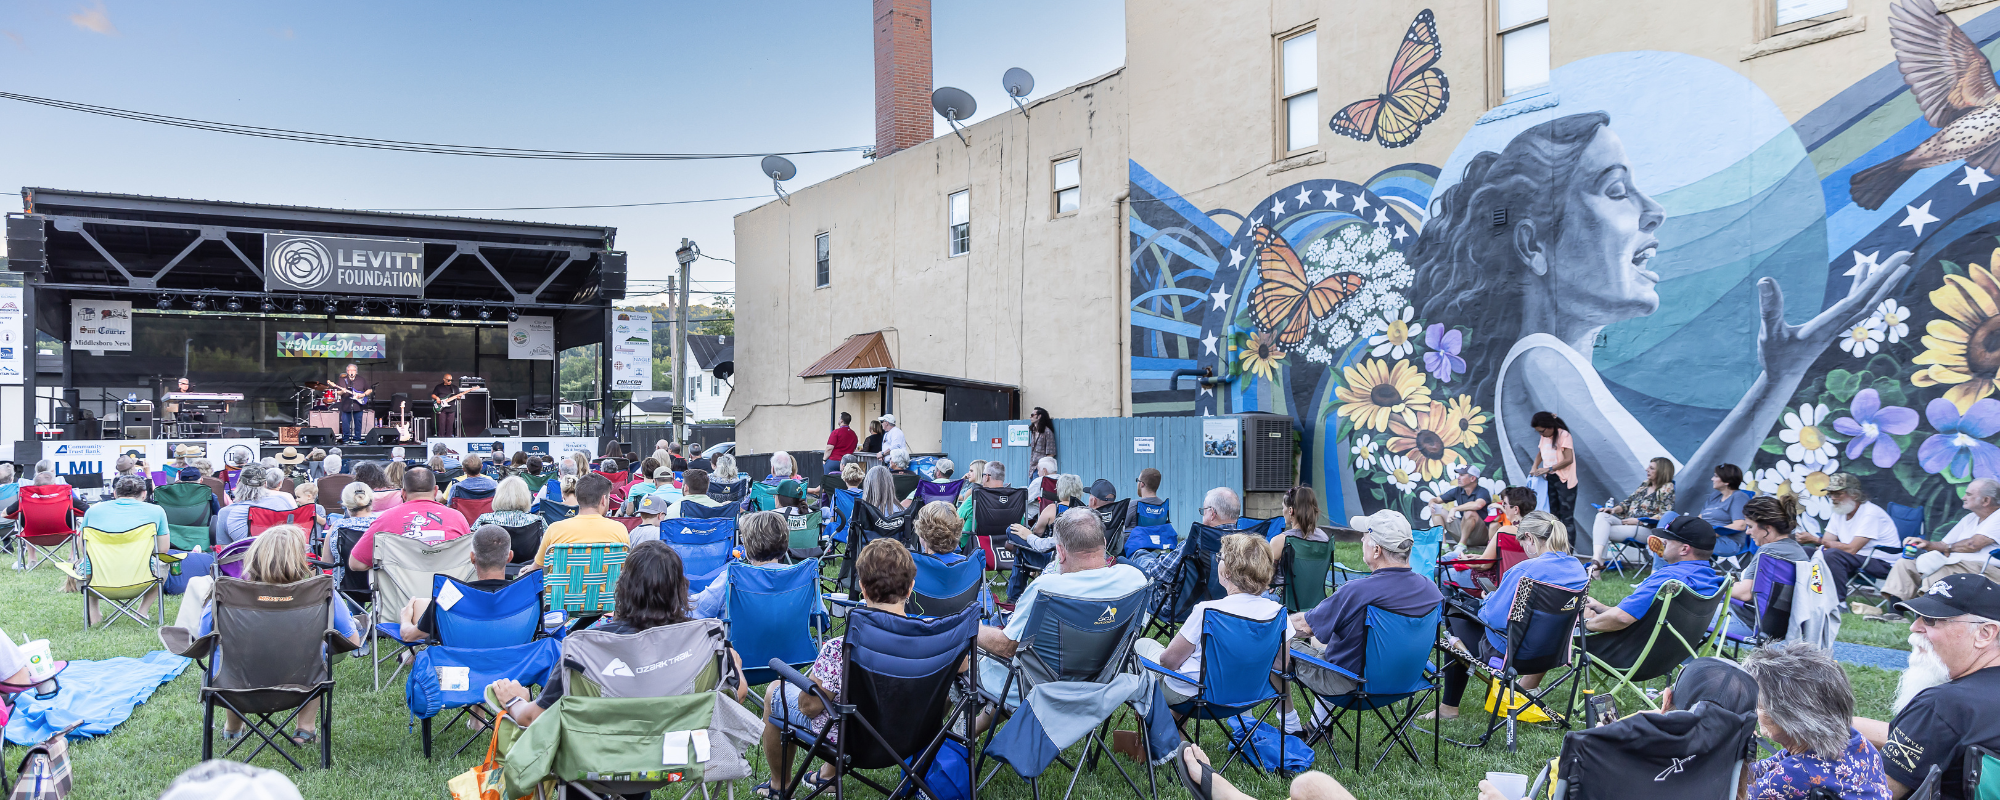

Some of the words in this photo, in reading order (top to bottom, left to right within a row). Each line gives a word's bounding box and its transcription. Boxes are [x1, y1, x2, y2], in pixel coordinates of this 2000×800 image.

[338, 249, 422, 269] LEVITT
[338, 269, 422, 288] FOUNDATION
[80, 326, 96, 334] Sun
[98, 326, 126, 335] Courier
[286, 338, 378, 352] #MusicMoves
[55, 461, 102, 475] LMU
[636, 660, 668, 674] OZARK
[668, 650, 693, 665] TRAIL
[1887, 744, 1900, 757] GS
[1904, 736, 1924, 752] STYLE
[1891, 757, 1913, 773] DEFEND
